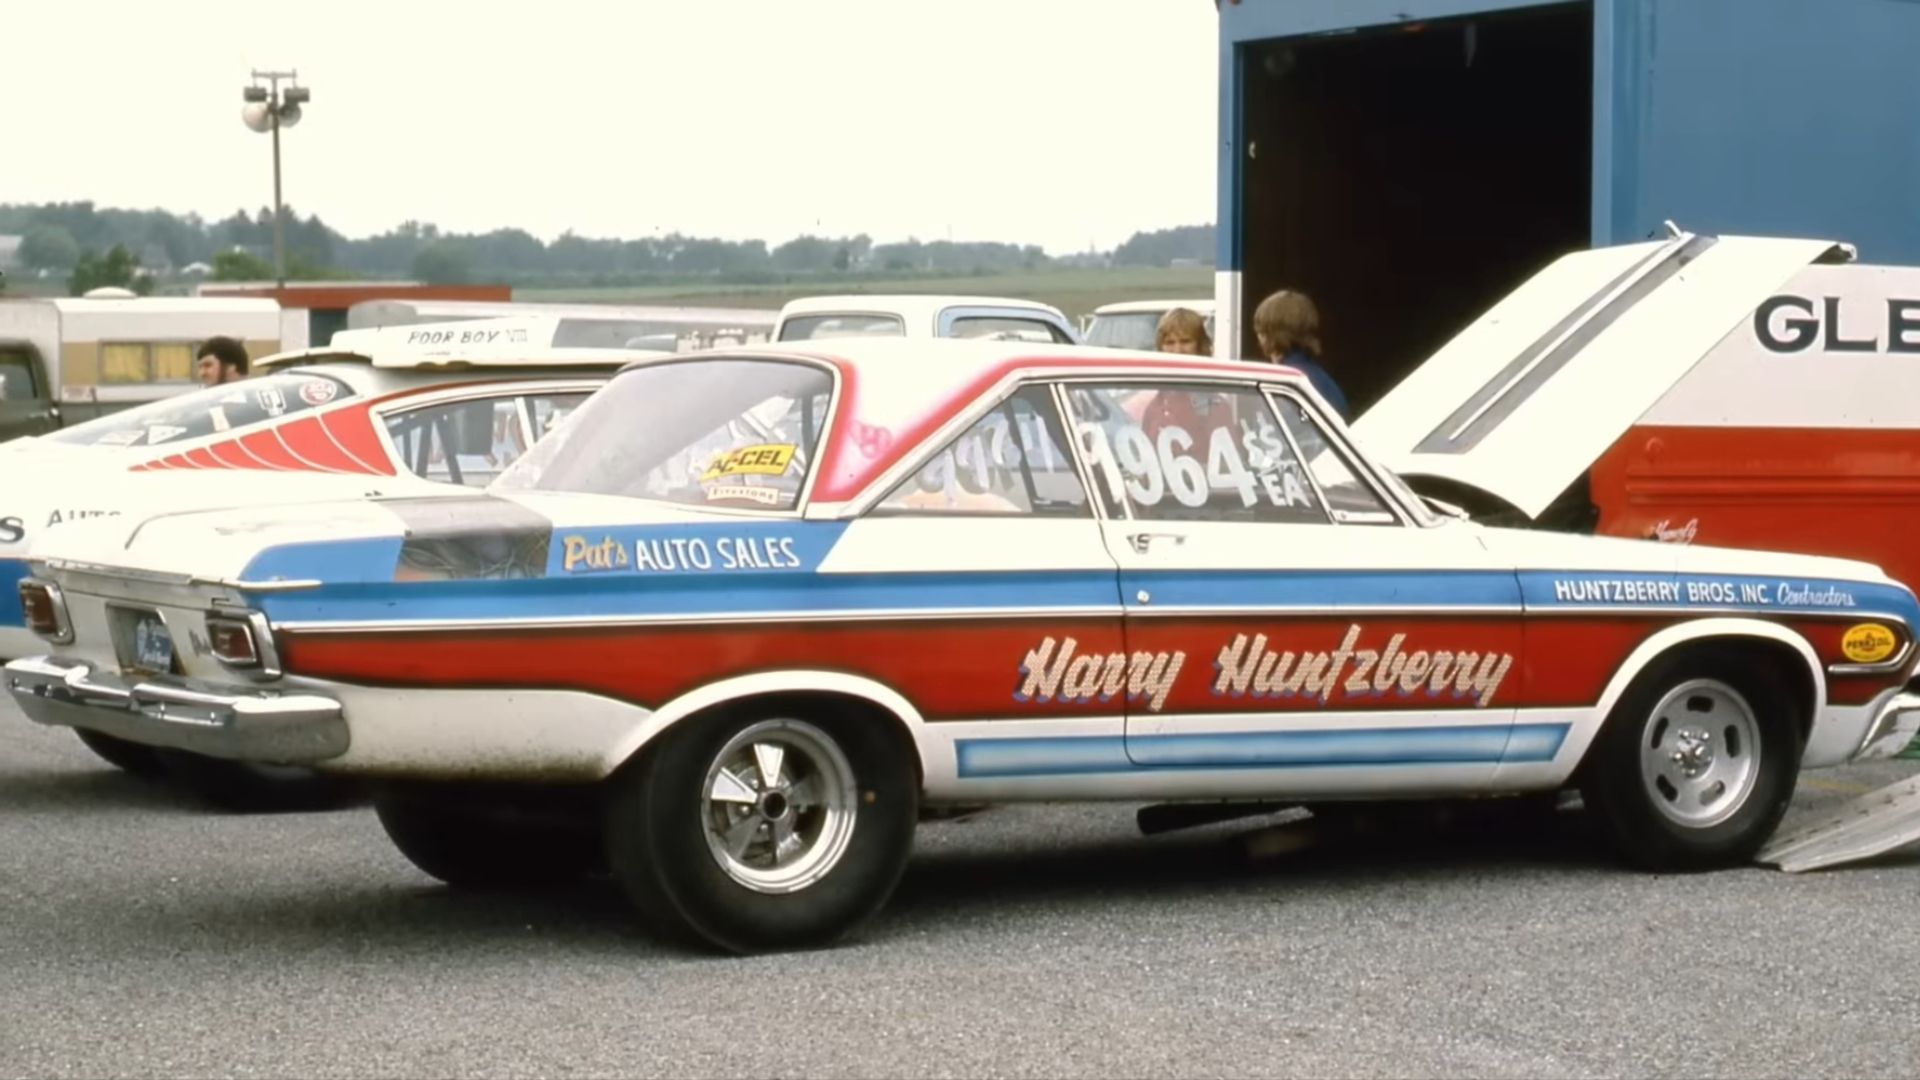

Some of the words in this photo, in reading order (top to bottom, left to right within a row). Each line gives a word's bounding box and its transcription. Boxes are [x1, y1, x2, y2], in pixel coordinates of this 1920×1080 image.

[407, 330, 455, 345] POOR
[460, 330, 500, 344] BOY
[707, 448, 785, 474] ACCEL
[1260, 471, 1313, 509] EA
[635, 538, 713, 571] AUTO
[716, 537, 801, 570] SALES
[1554, 579, 1681, 602] HUNTZBERRY
[1018, 636, 1186, 712] Harry
[1211, 622, 1515, 709] Huntzberry
